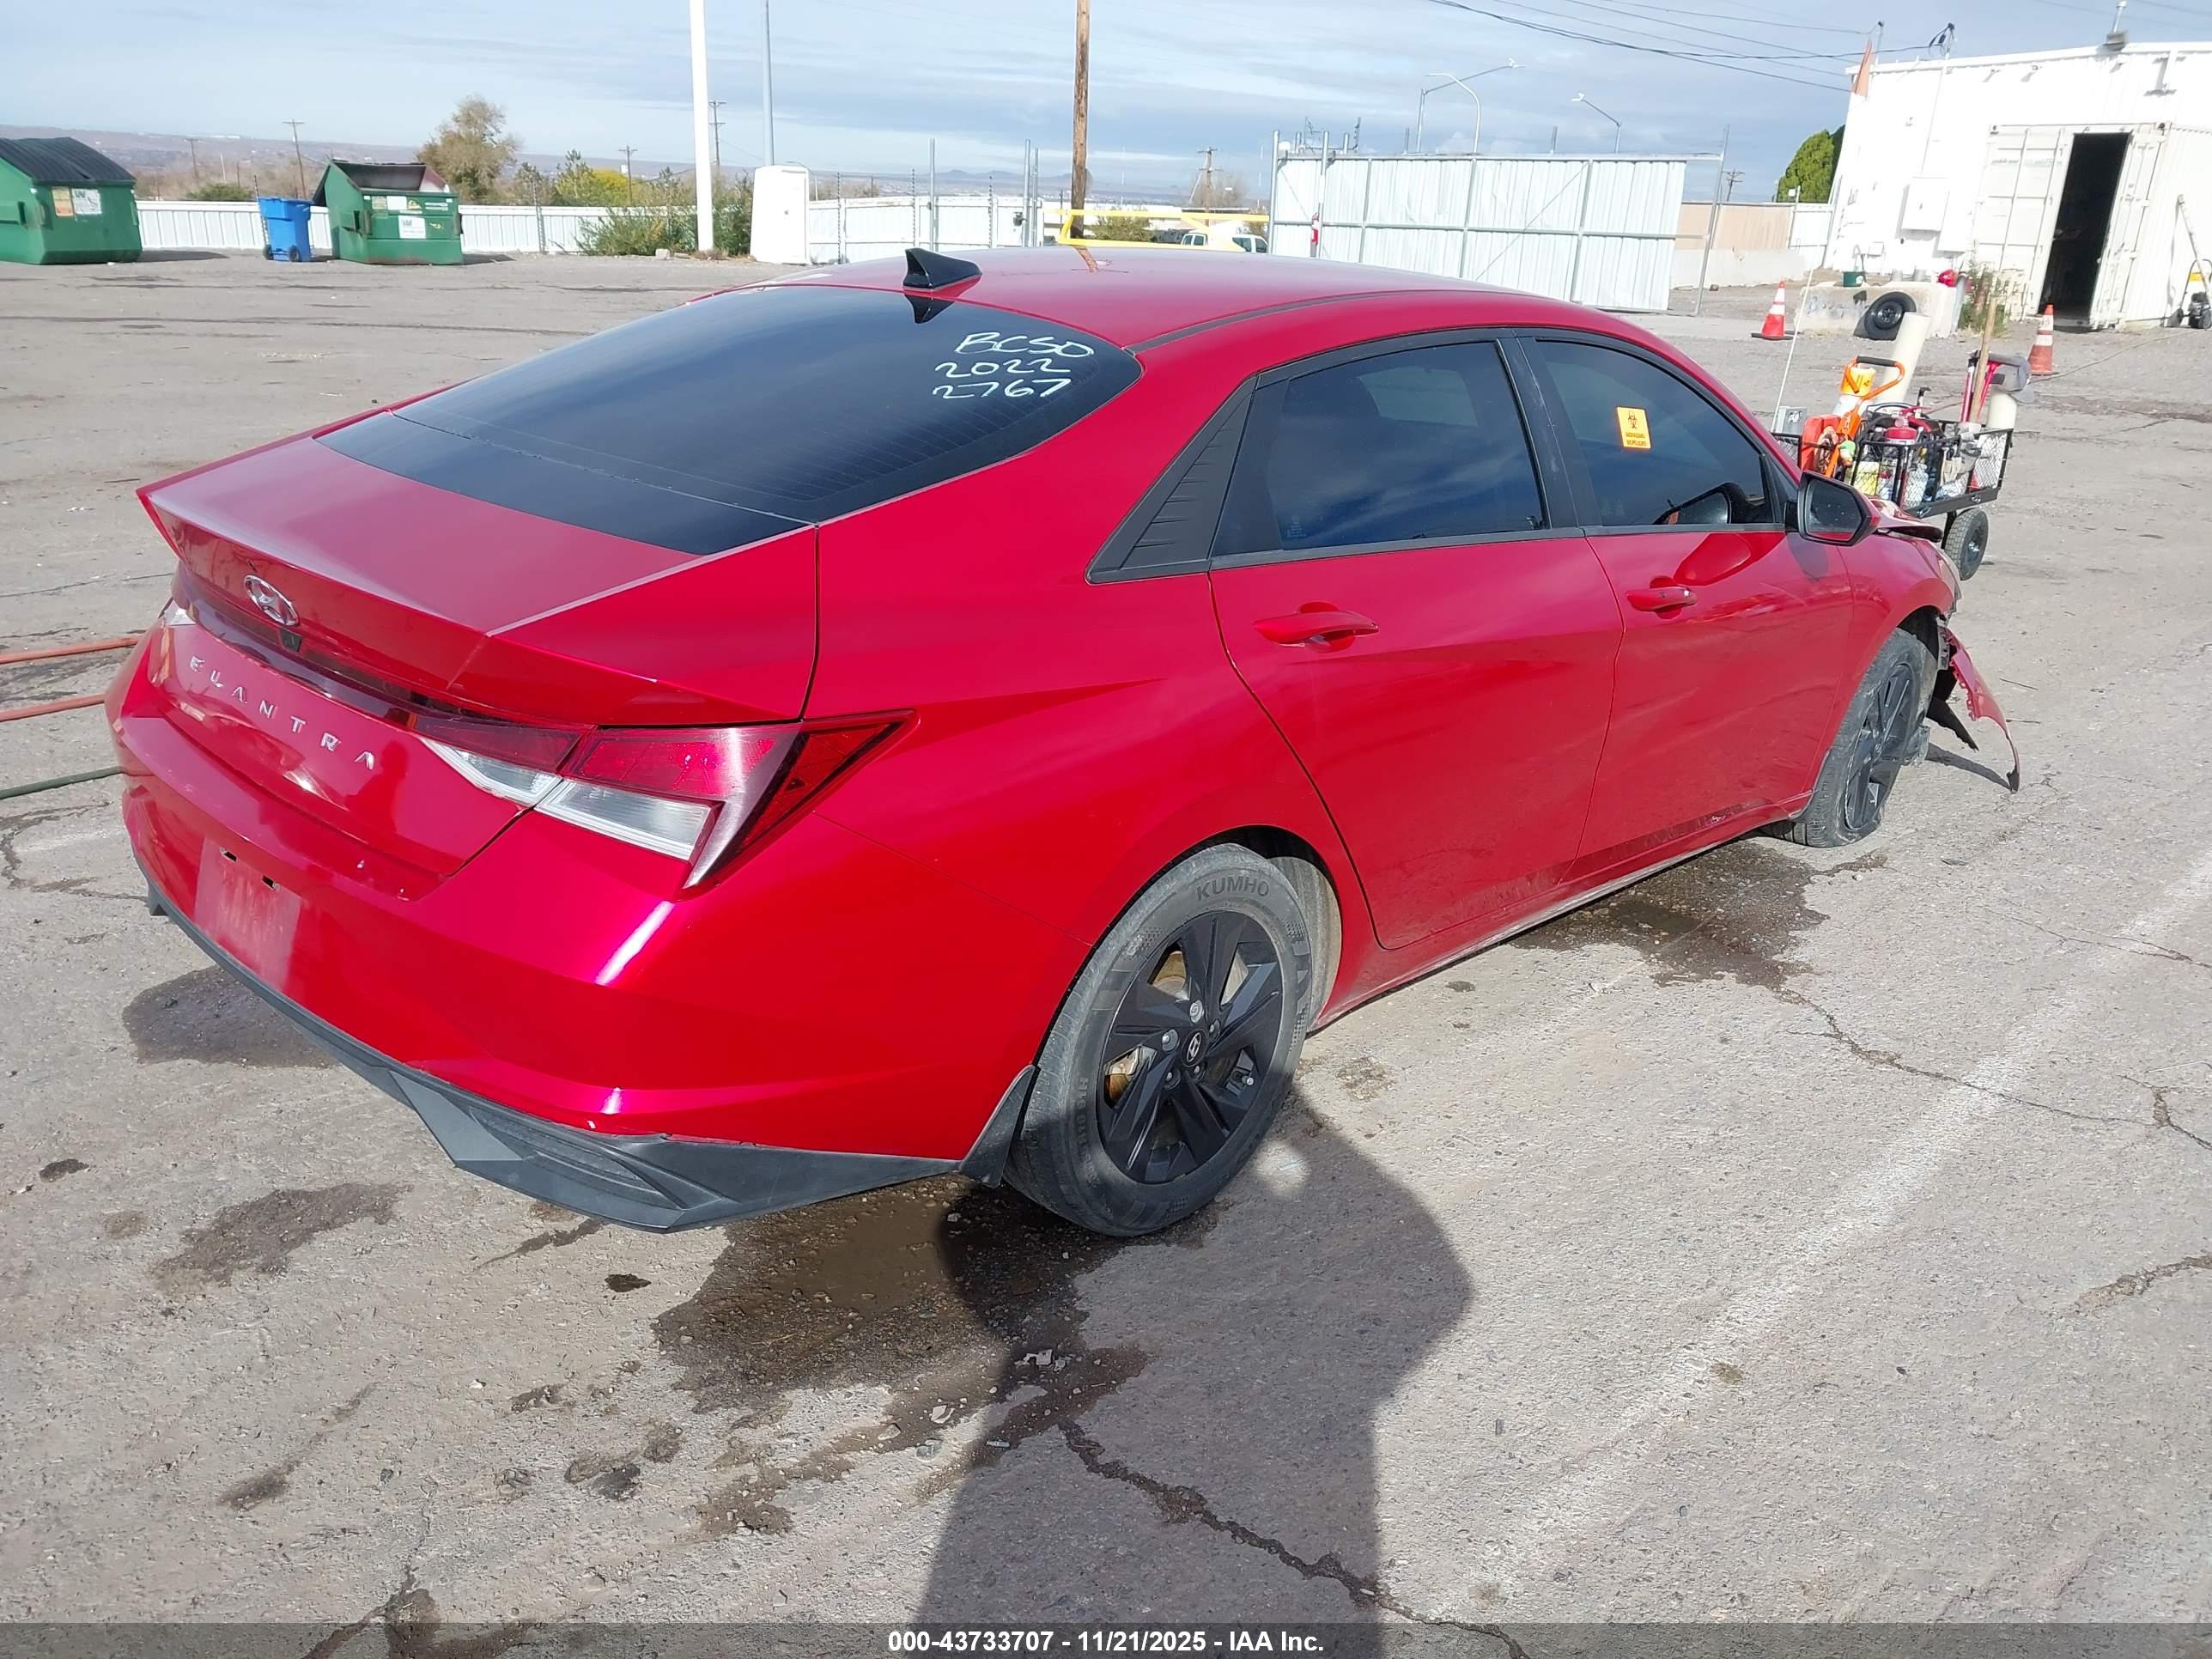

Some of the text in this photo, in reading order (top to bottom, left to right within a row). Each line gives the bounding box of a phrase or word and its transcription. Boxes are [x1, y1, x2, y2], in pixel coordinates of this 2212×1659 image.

[954, 331, 1095, 358] BCSO
[934, 357, 1071, 379] 2022
[932, 378, 1072, 399] 2767
[189, 655, 376, 770] ELANTRA
[1196, 876, 1270, 902] KUMHO
